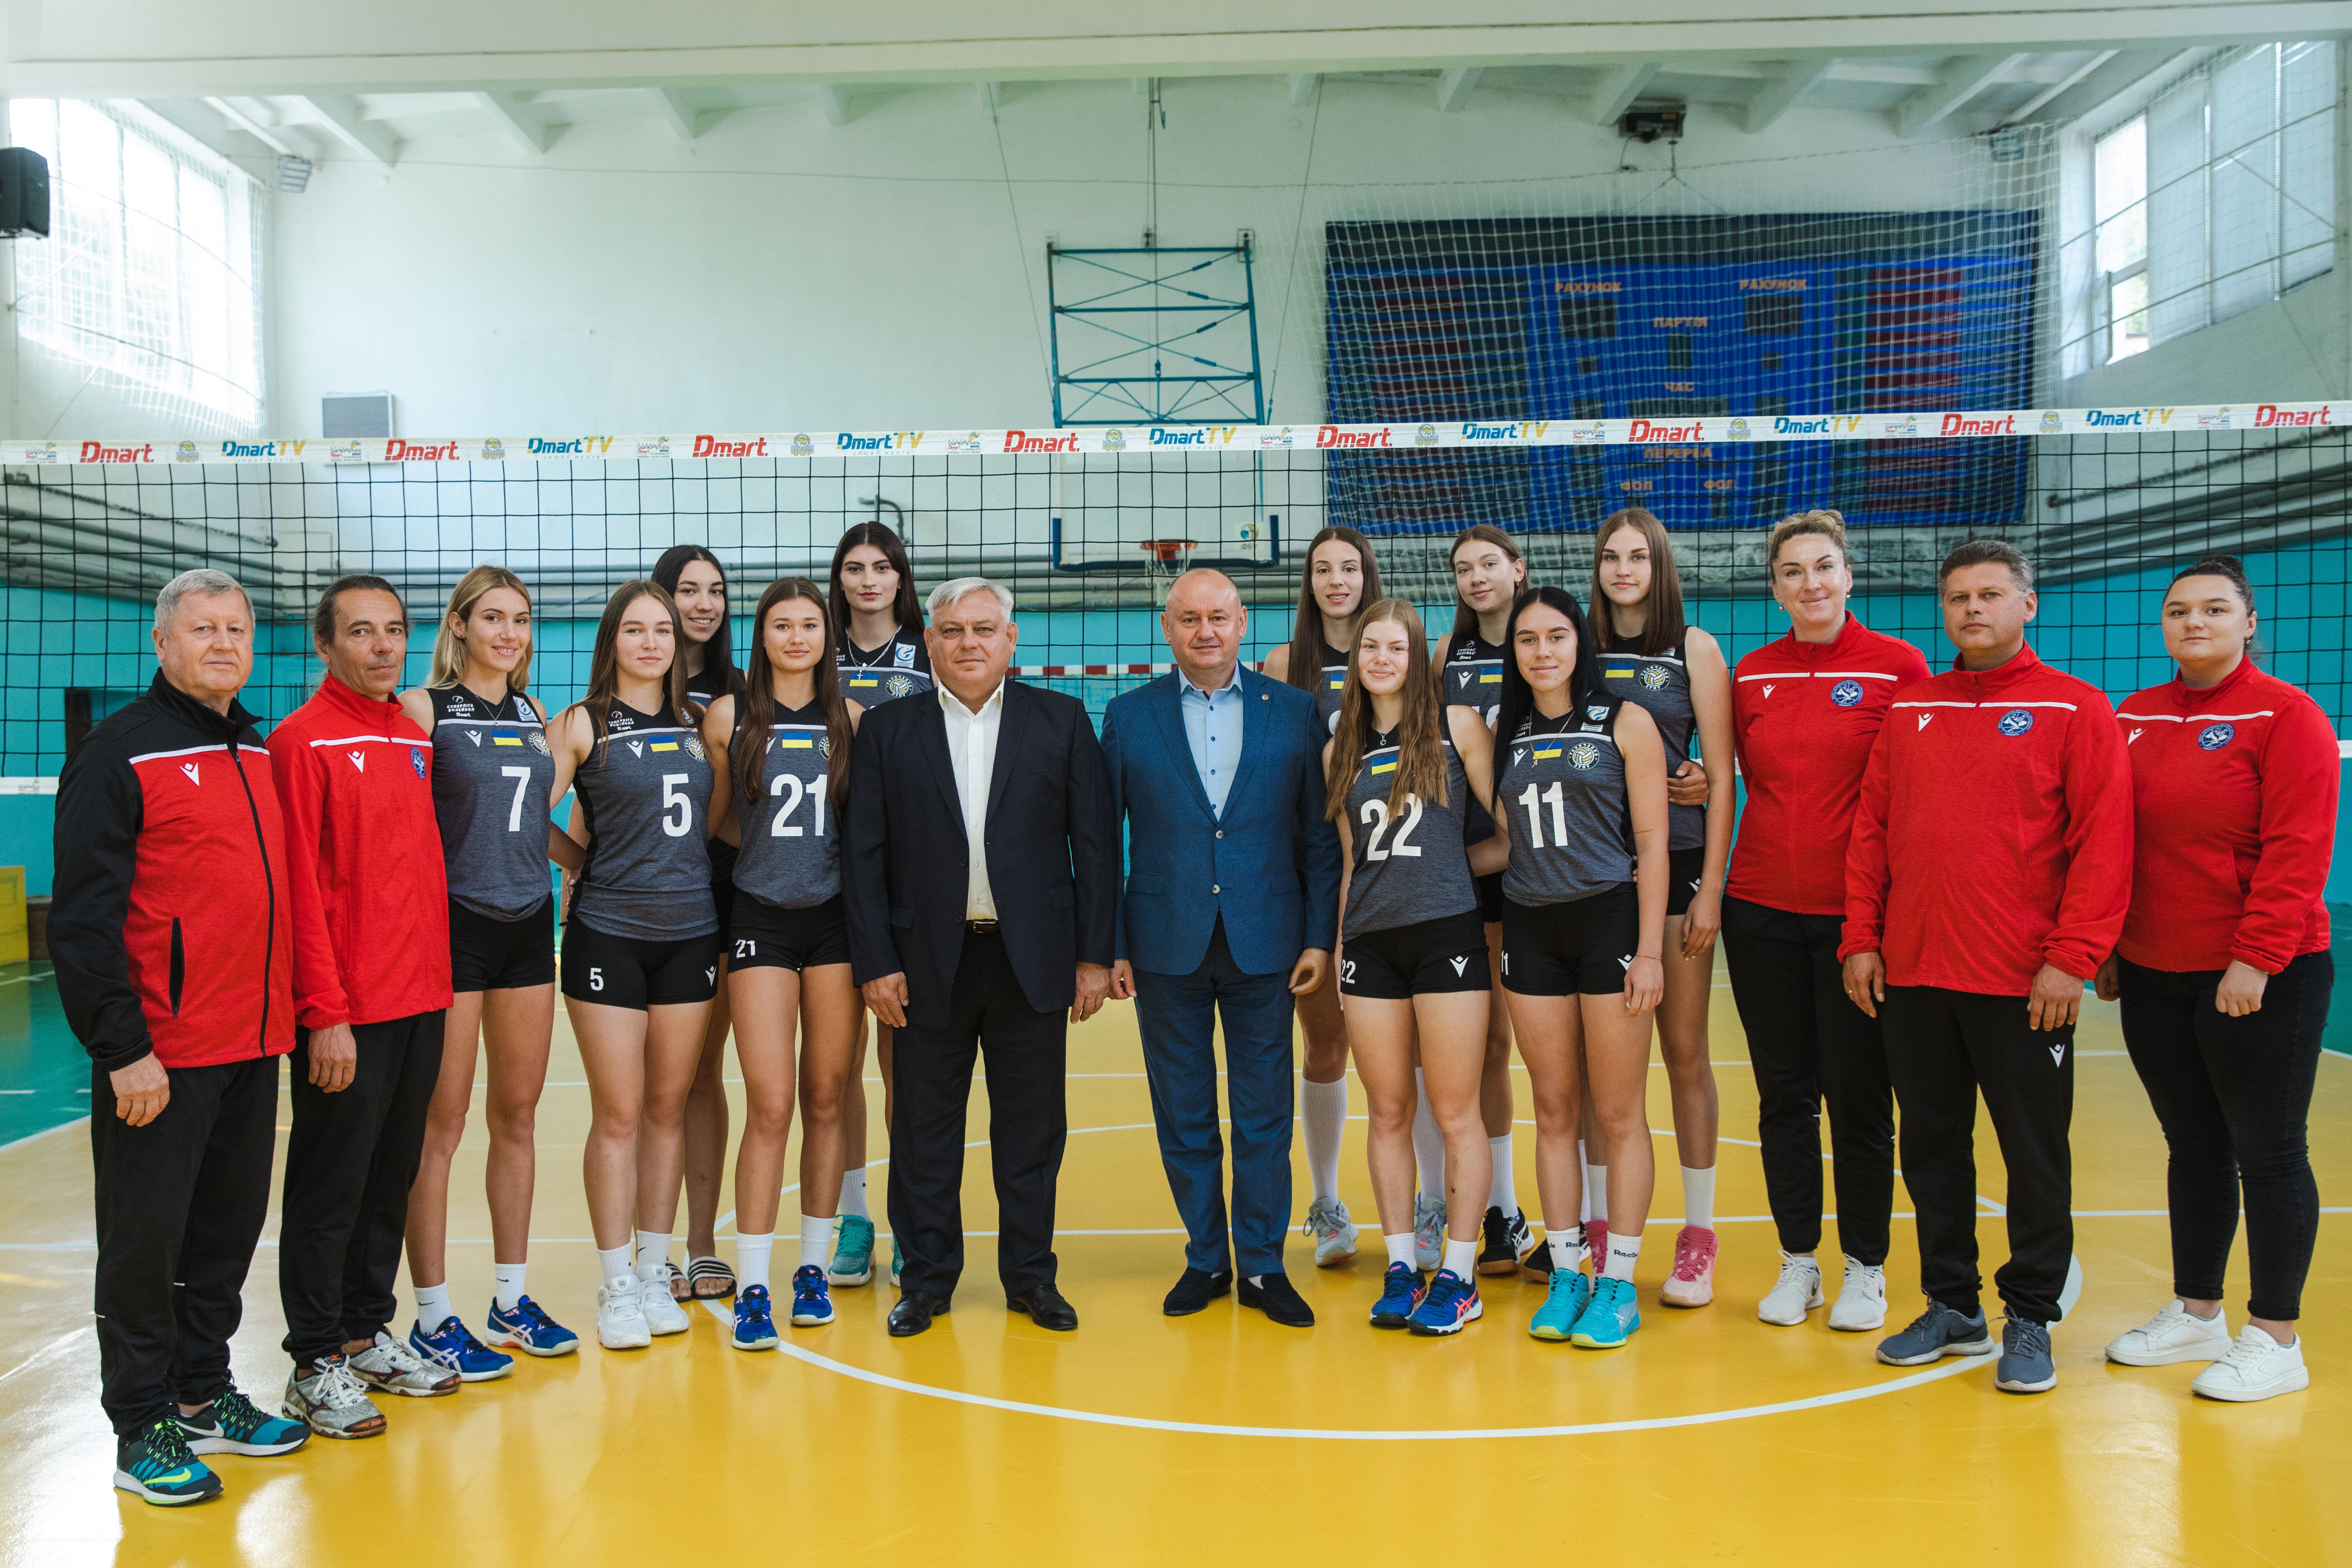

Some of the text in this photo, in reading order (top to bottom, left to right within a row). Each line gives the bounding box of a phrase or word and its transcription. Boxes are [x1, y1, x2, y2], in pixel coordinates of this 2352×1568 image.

[1555, 282, 1621, 293] РАХУНОК
[1739, 279, 1807, 290] РАХУНОК
[1653, 317, 1707, 327] ПАРТІЯ
[1665, 382, 1694, 392] ЧАС
[1621, 481, 1652, 491] ФОЛ
[1704, 479, 1735, 489] ФОЛ
[1641, 666, 1669, 679] ГАЛИЧАНКА
[1569, 743, 1598, 756] ГАЛИЧАНКА
[501, 766, 531, 832] 7
[662, 773, 691, 837] 5
[771, 774, 828, 837] 21
[1519, 781, 1568, 849] 11
[1360, 792, 1423, 861] 22
[736, 940, 755, 958] 21
[1341, 959, 1356, 984] 22
[590, 968, 603, 991] 5
[1614, 1249, 1638, 1257] Reeb
